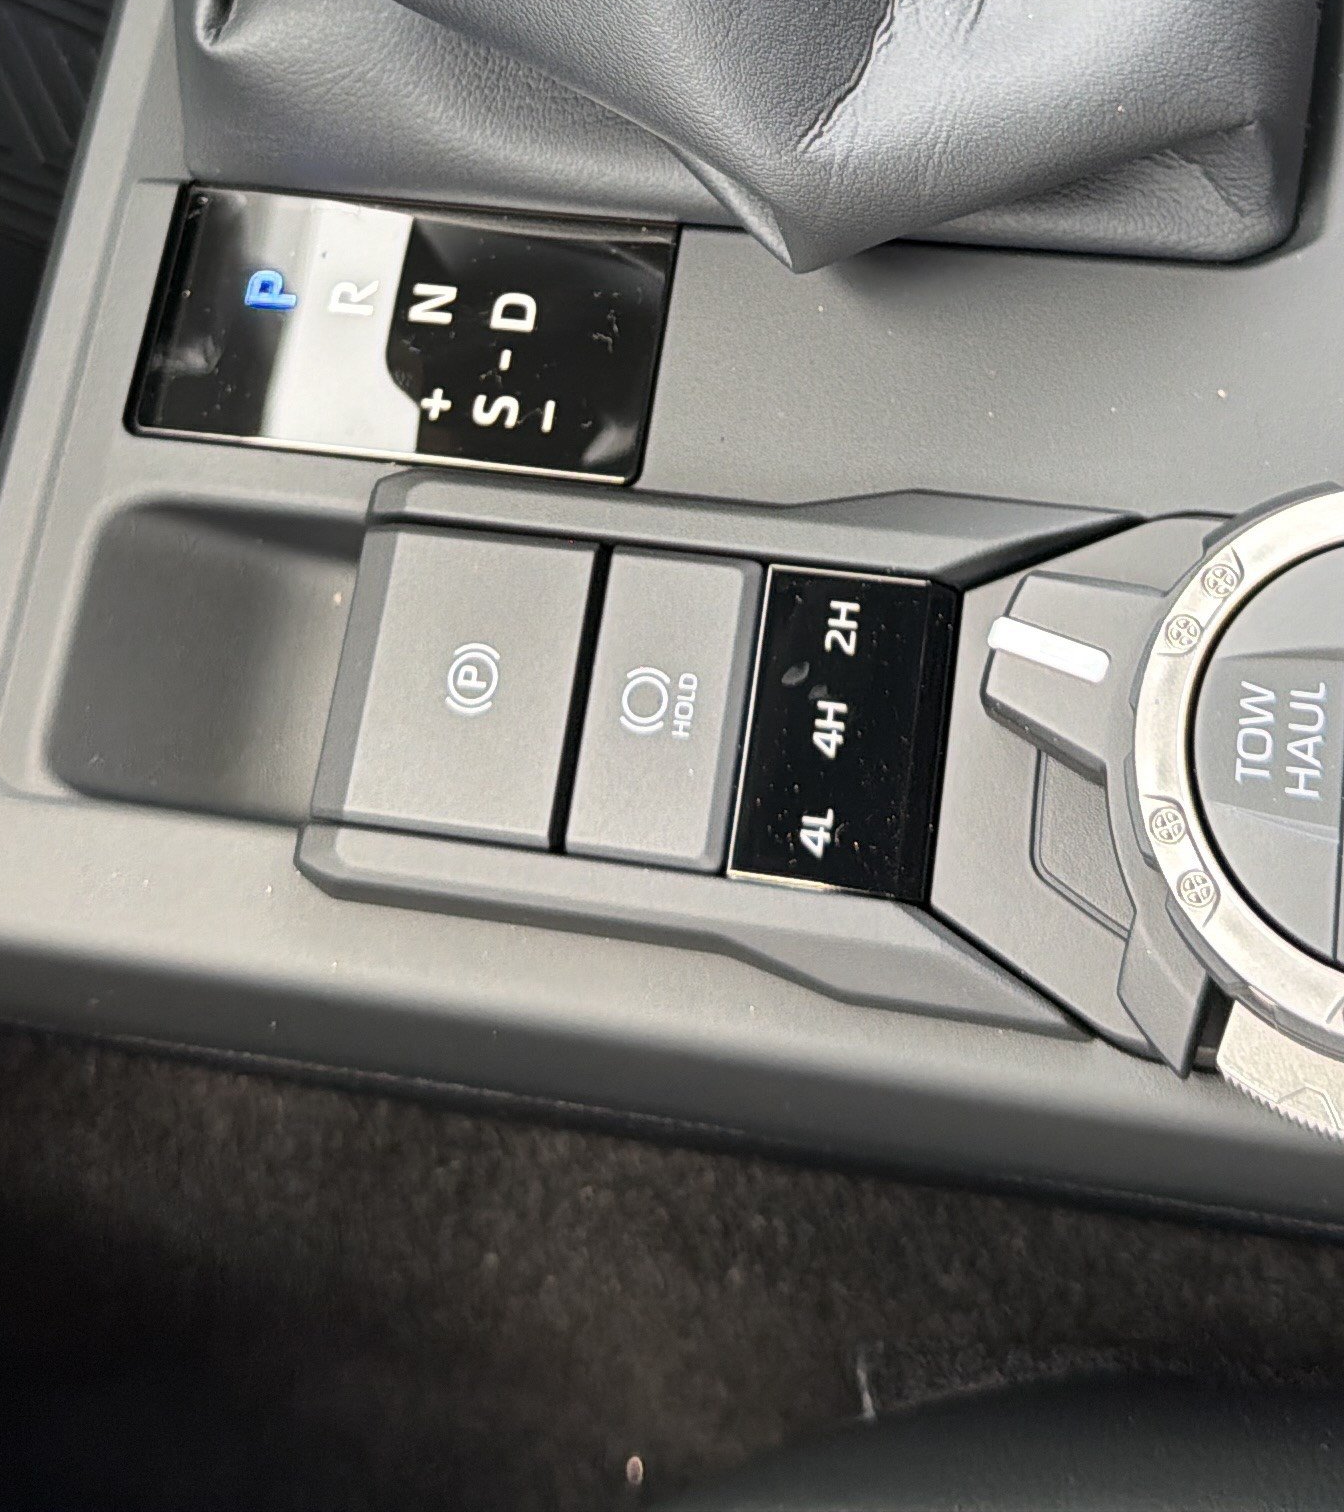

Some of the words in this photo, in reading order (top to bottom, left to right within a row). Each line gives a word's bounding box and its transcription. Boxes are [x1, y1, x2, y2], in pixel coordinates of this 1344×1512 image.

[244, 270, 297, 310] P
[328, 280, 379, 316] R
[408, 283, 458, 324] N
[490, 292, 537, 332] D
[472, 394, 520, 429] S
[824, 600, 860, 657] 2H
[672, 672, 698, 739] HOLD
[812, 700, 848, 760] 4H
[1235, 681, 1276, 785] TOW
[1284, 682, 1327, 801] HAUL
[800, 808, 834, 859] 4L
